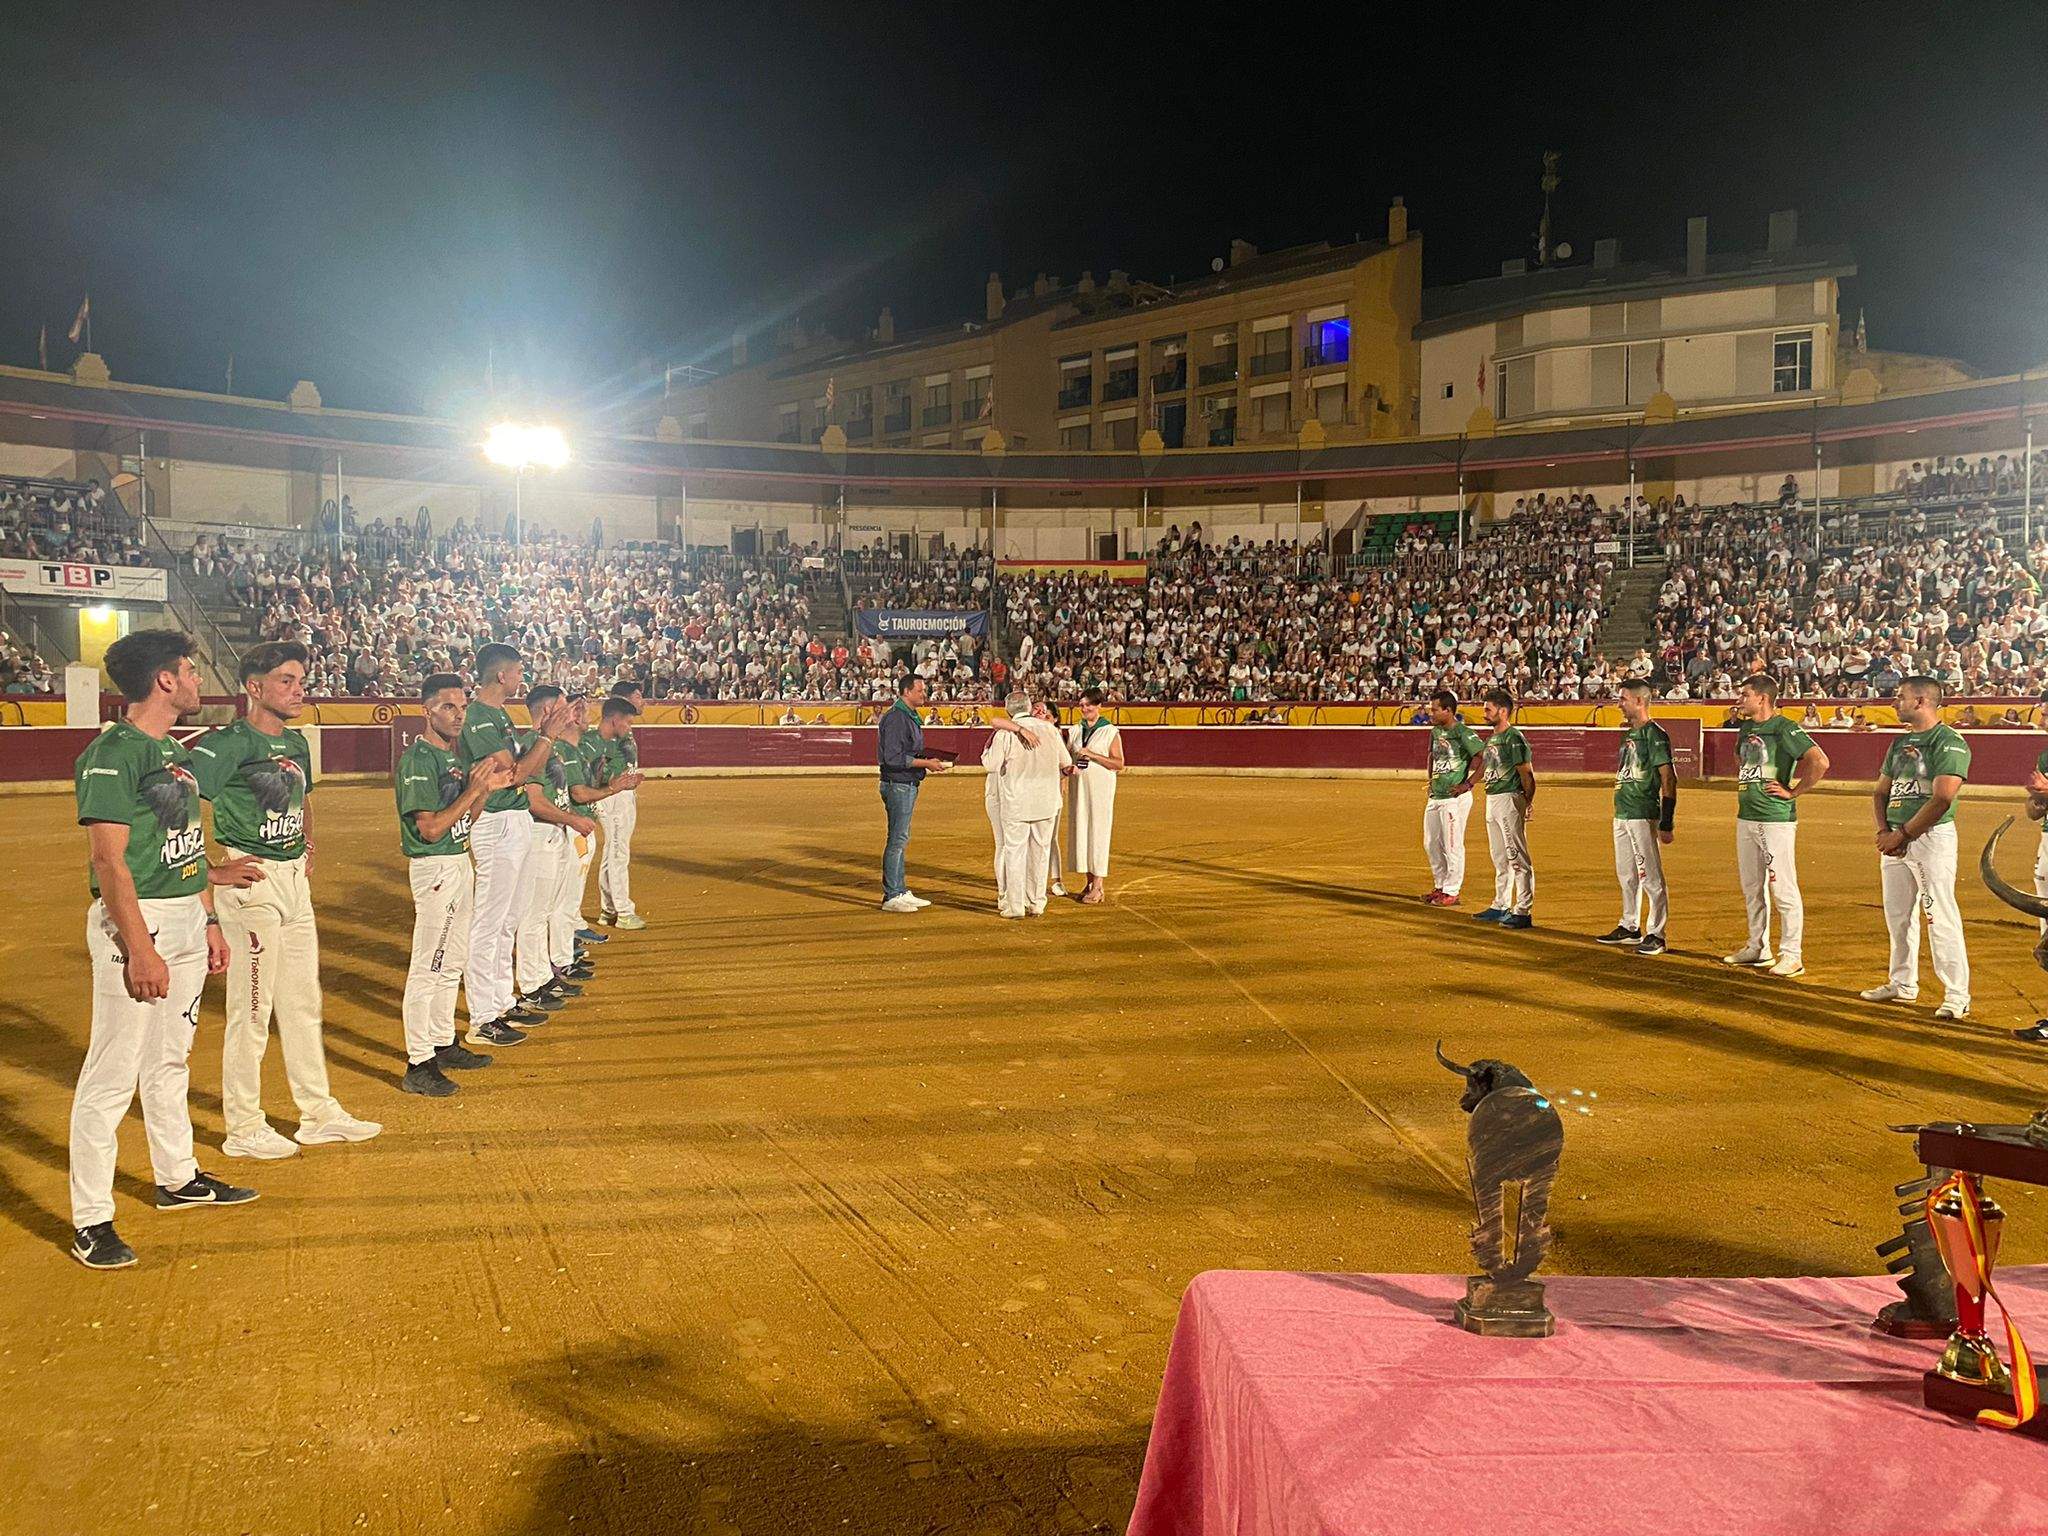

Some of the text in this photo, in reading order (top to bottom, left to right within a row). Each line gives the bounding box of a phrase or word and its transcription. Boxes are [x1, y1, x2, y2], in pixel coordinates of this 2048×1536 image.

[42, 565, 111, 586] TBP
[892, 616, 967, 631] TAUROEMOCIÓN
[378, 707, 388, 721] 6
